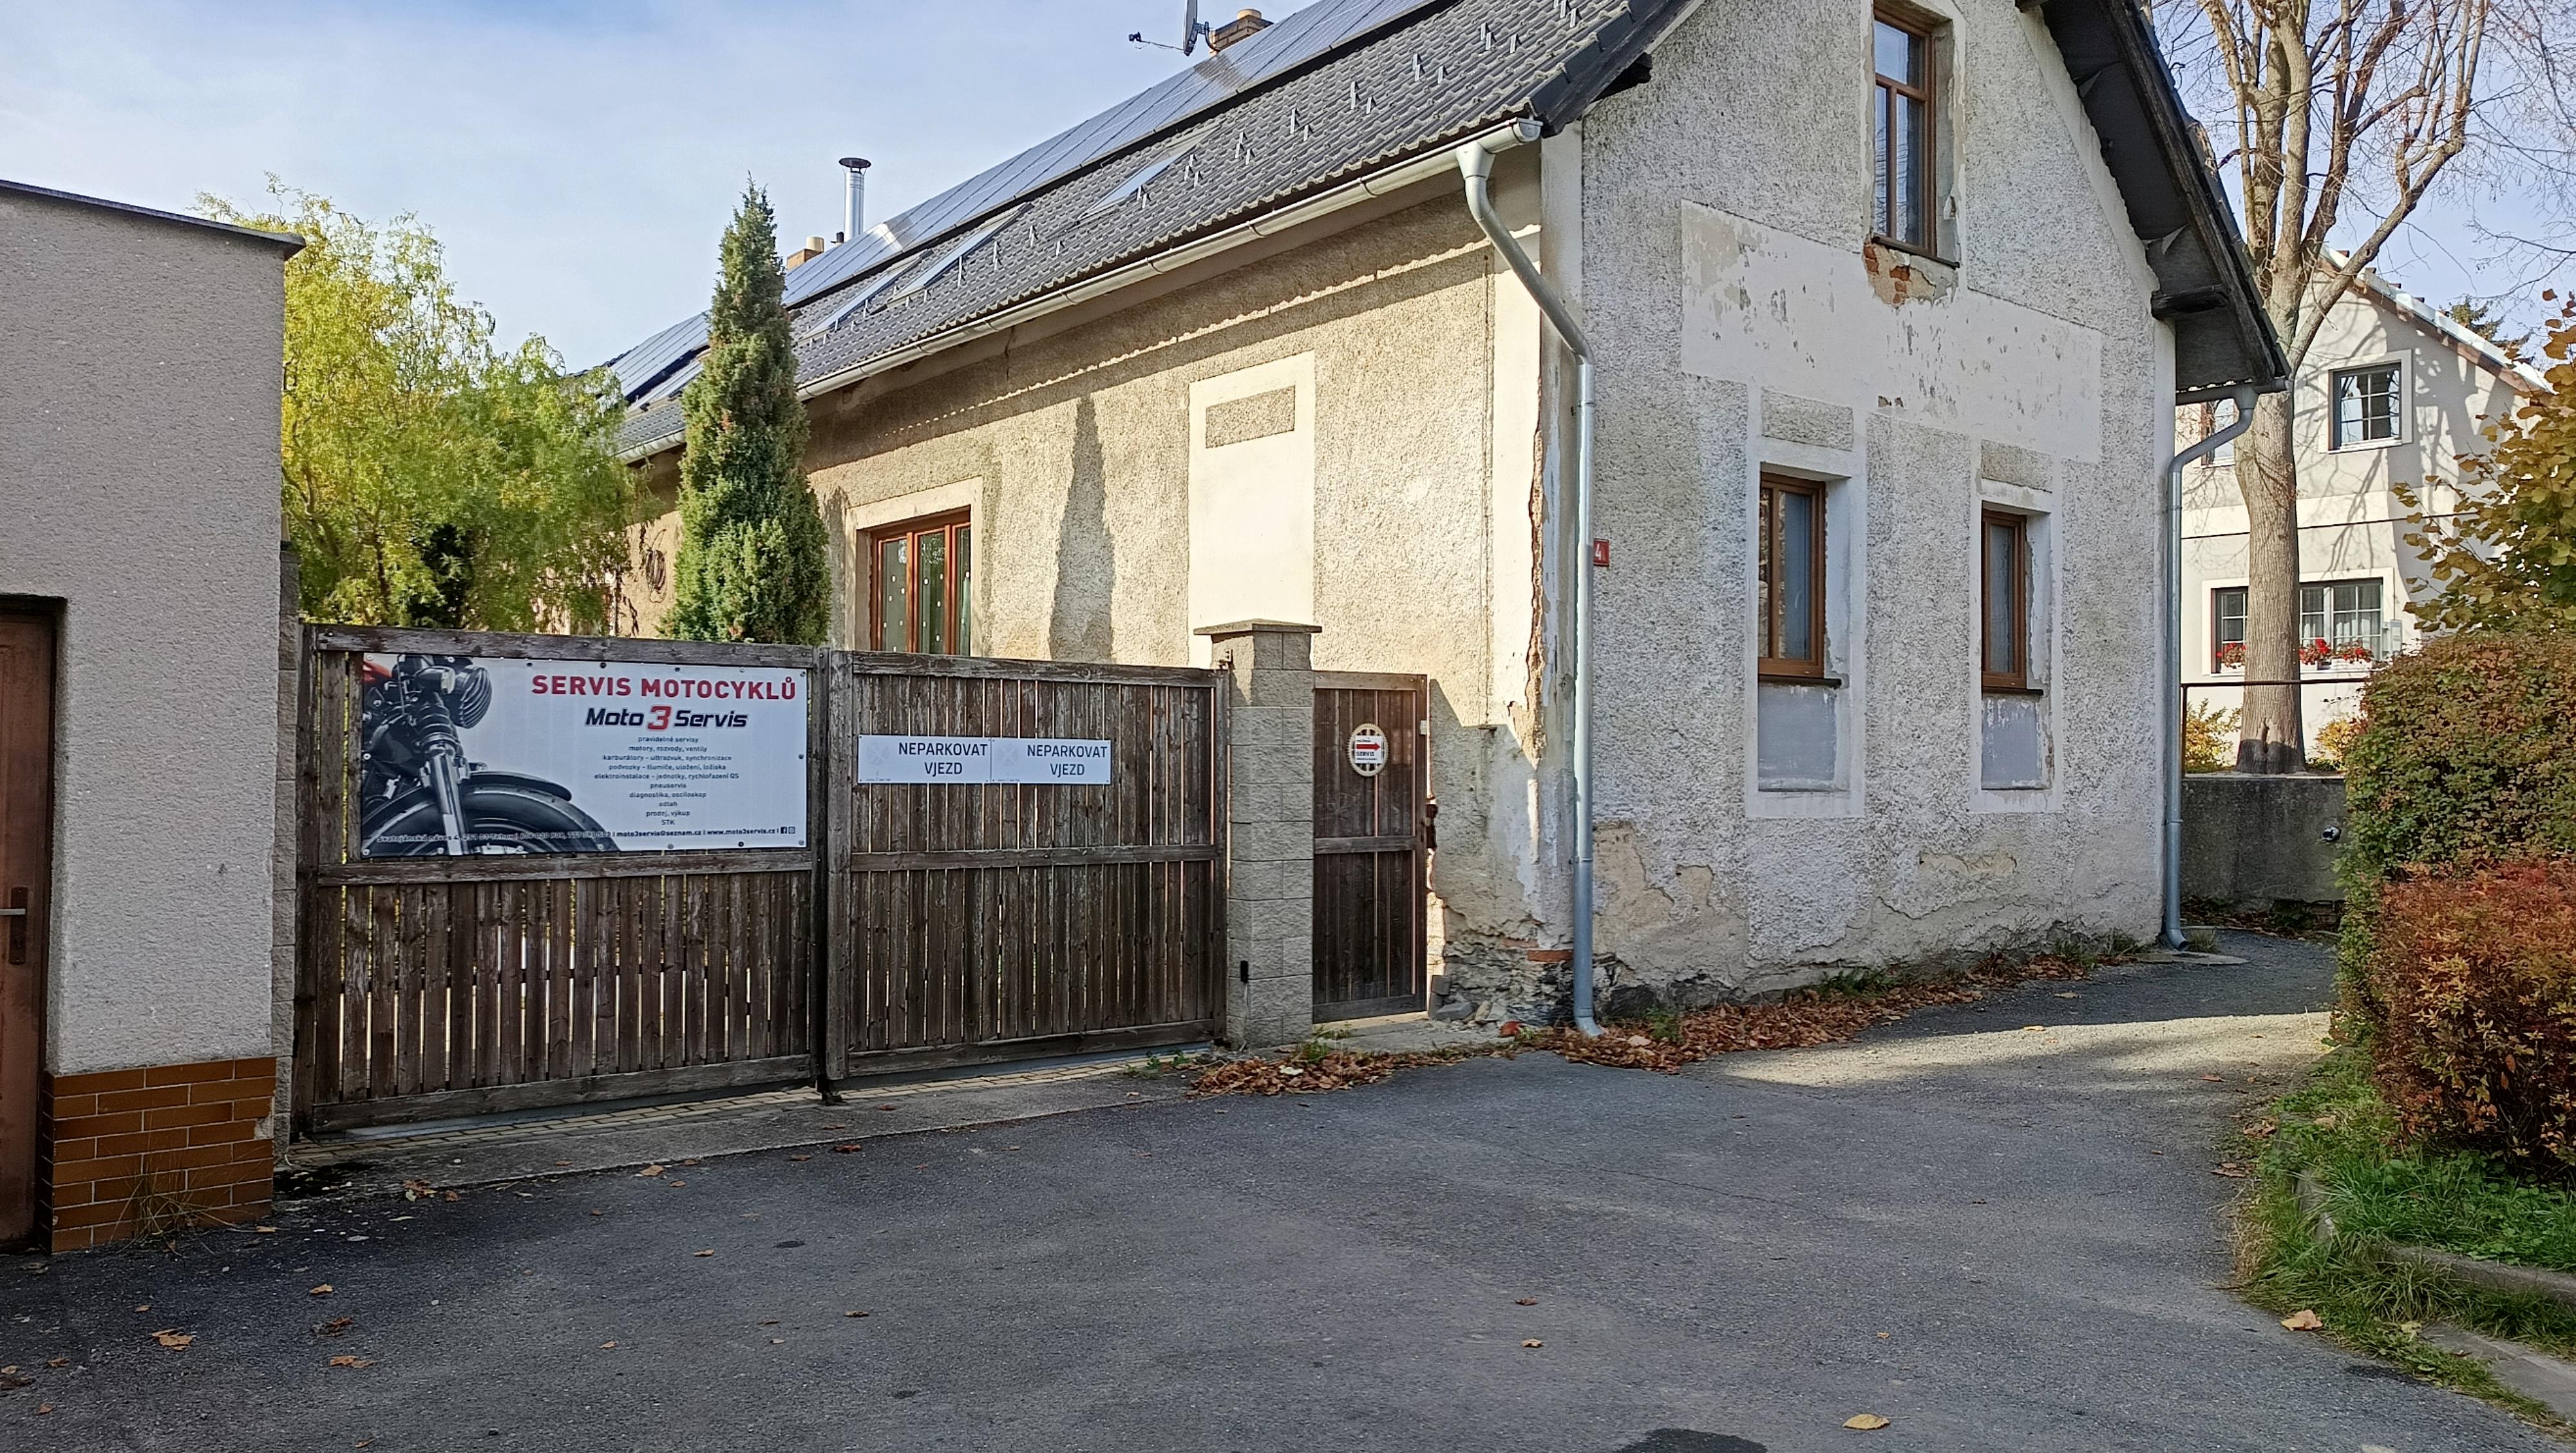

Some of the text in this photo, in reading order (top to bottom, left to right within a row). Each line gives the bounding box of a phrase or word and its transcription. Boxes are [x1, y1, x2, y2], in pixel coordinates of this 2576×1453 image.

[1595, 543, 1602, 560] 4
[532, 675, 795, 699] SERVIS MOTOCYKLŮ
[585, 705, 748, 730] Moto 3 Servis
[898, 743, 987, 756] NEPARKOVAT
[1027, 745, 1108, 758] NEPARKOVAT
[924, 762, 963, 777] VJEZD
[1050, 763, 1085, 778] VJEZD
